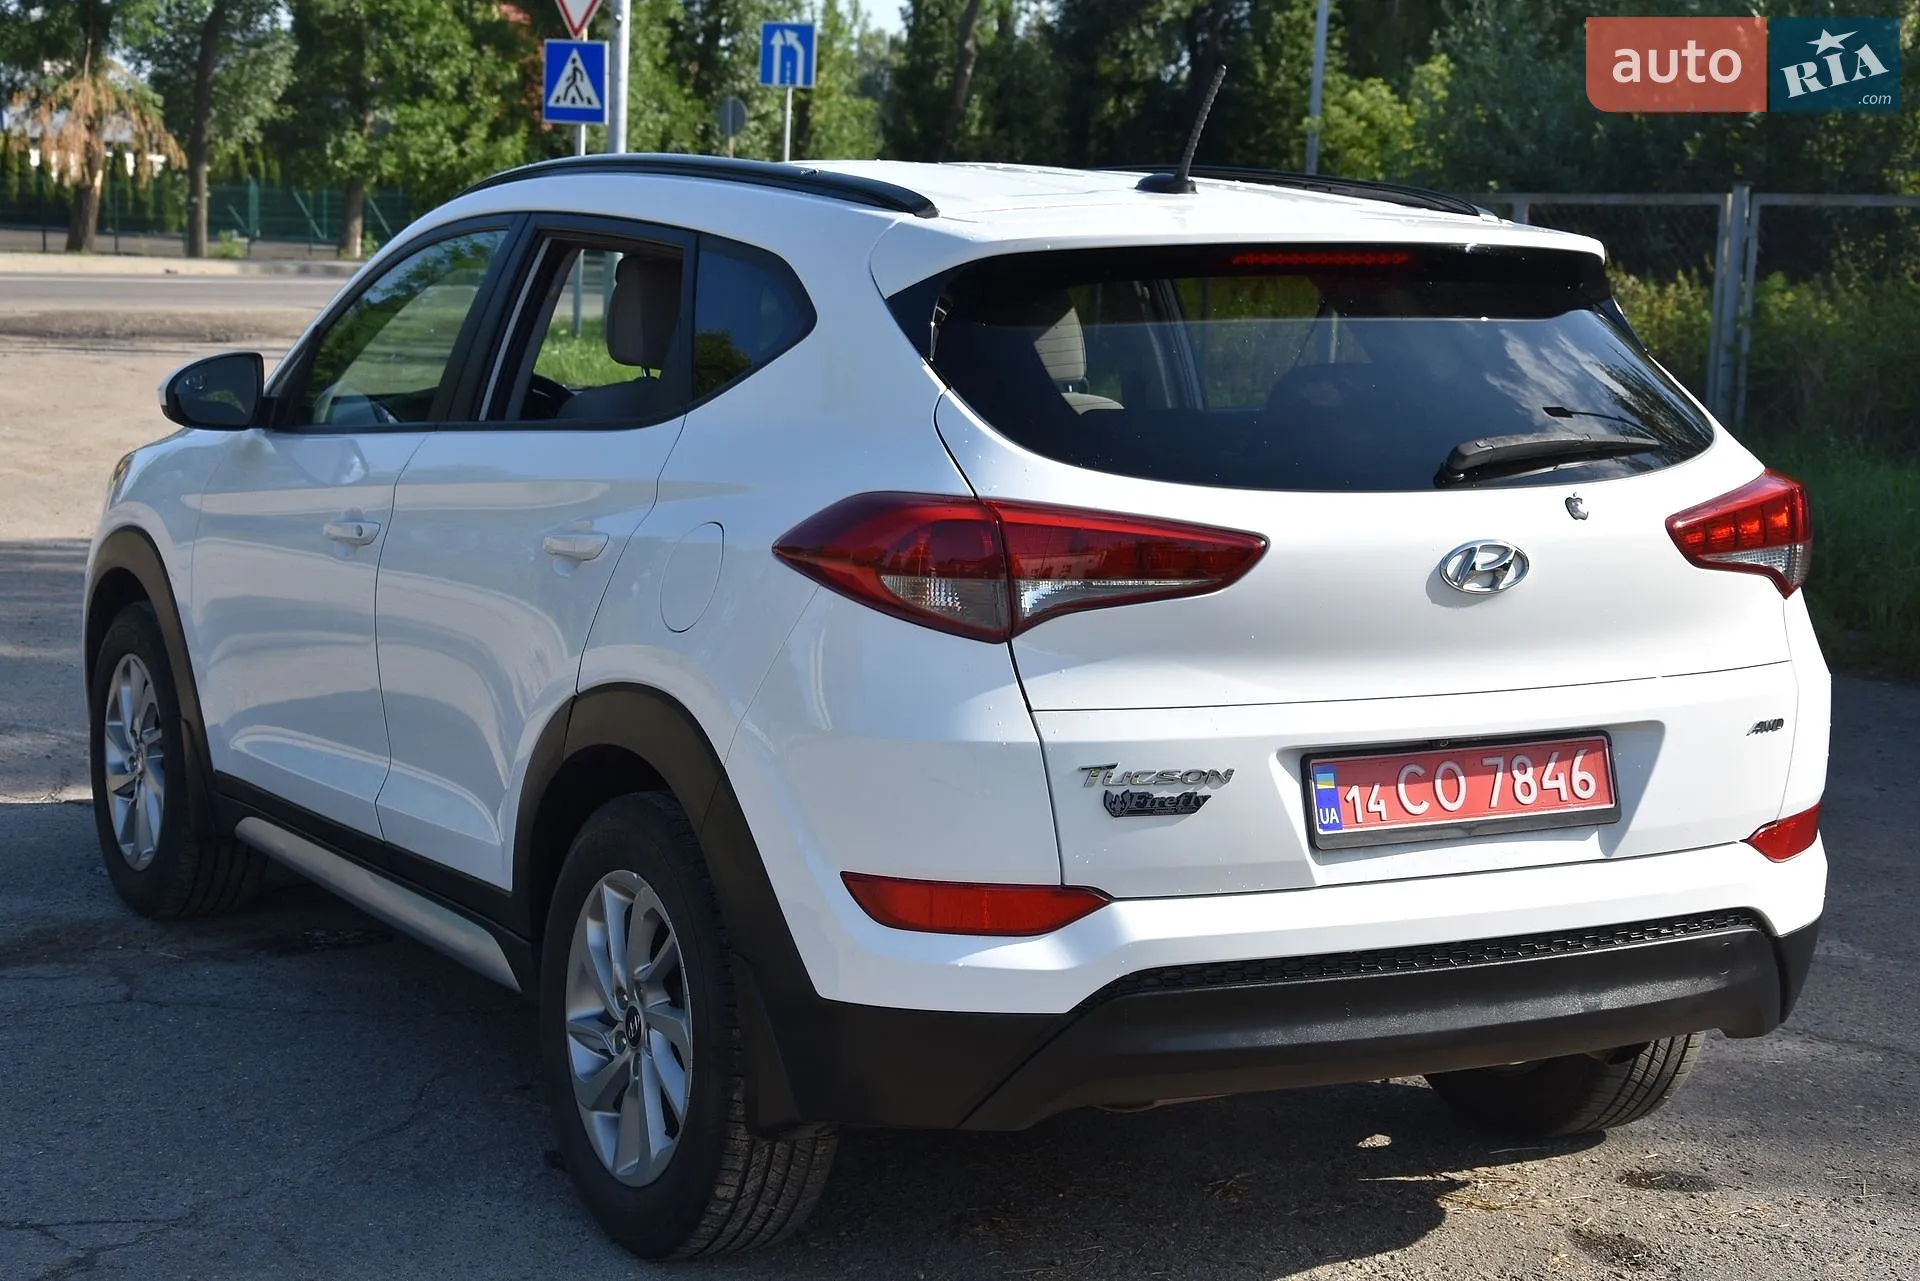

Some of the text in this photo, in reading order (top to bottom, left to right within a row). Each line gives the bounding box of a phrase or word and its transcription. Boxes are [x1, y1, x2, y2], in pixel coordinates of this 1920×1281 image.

[1747, 718, 1784, 736] AWD
[1344, 749, 1597, 823] 14 CO 7846
[1130, 791, 1209, 809] Firefly
[1320, 807, 1339, 825] UA
